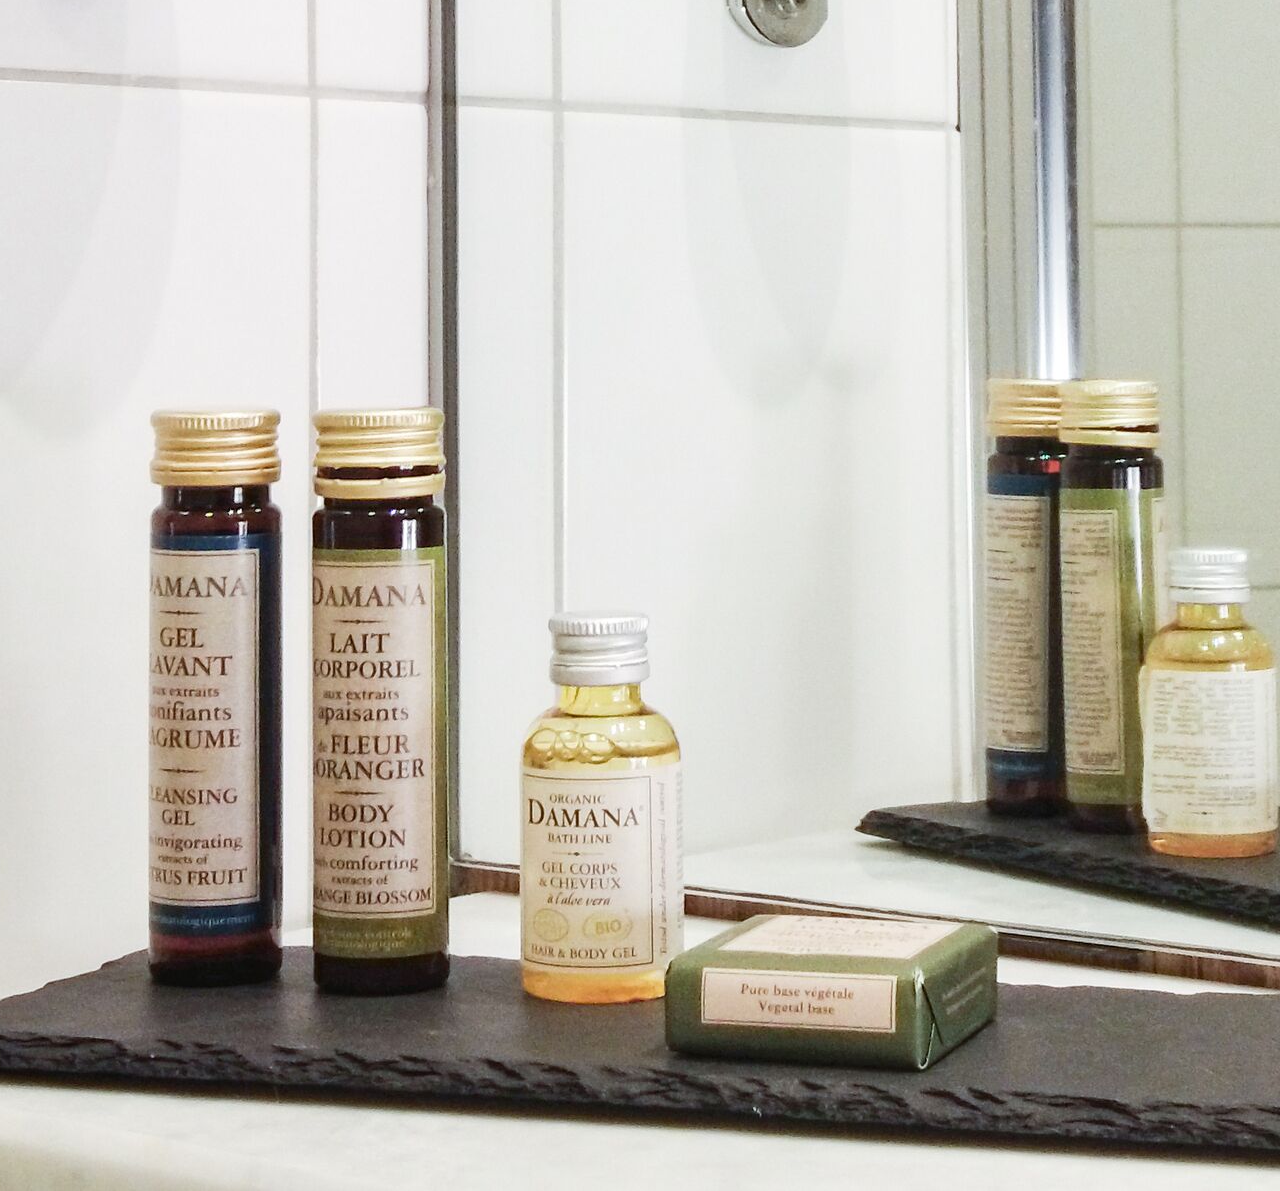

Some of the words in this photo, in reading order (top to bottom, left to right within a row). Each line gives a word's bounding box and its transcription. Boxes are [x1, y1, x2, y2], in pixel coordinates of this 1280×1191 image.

[313, 576, 427, 607] DAMANA
[160, 627, 204, 648] GEL
[329, 633, 391, 654] LAIT
[314, 659, 420, 679] CORPOREL
[169, 686, 220, 698] extraits
[323, 691, 342, 700] aux
[346, 689, 400, 700] extraits
[318, 702, 409, 725] apaisants
[331, 734, 410, 755] FLEUR
[150, 785, 239, 805] LEANSING
[549, 793, 606, 806] ORGANIC
[162, 809, 195, 826] GEL
[329, 803, 394, 823] BODY
[528, 798, 640, 828] DAMANA
[320, 828, 406, 848] LOTION
[548, 832, 579, 844] BATH
[582, 834, 613, 845] LINE
[196, 854, 208, 865] of
[330, 854, 419, 872] comforting
[542, 861, 567, 874] GEL
[570, 862, 618, 876] CORPS
[188, 867, 247, 886] FRUIT
[332, 875, 372, 885] extracts
[376, 875, 389, 885] of
[539, 878, 548, 888] &
[550, 877, 622, 890] CHEVEUX
[356, 887, 431, 906] BLOSSOM
[586, 897, 611, 907] vera
[531, 944, 555, 957] HAIR
[570, 947, 608, 960] BODY
[612, 946, 638, 958] GEL
[741, 983, 769, 996] Pure
[773, 984, 800, 997] base
[804, 986, 855, 1001] végétale
[758, 1000, 804, 1015] Vegetal
